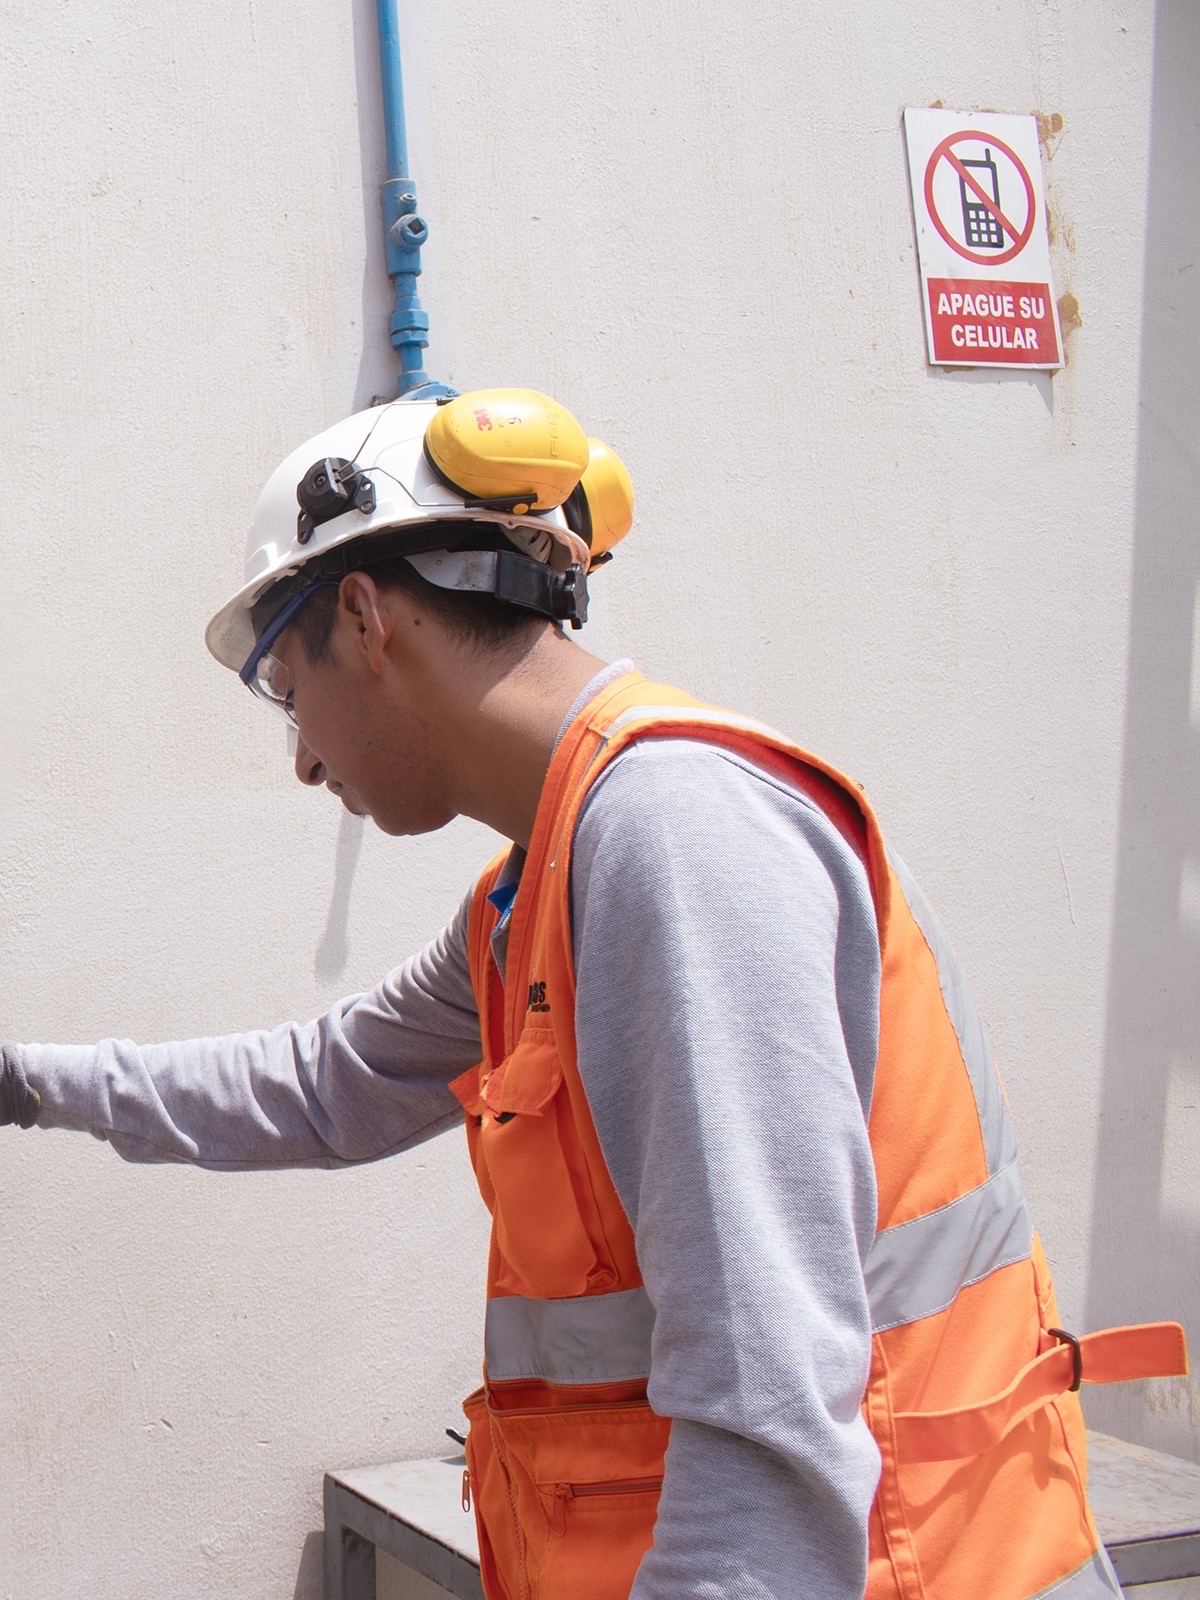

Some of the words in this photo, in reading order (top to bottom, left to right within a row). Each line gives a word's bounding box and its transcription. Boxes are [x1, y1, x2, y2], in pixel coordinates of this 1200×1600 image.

[937, 293, 1015, 318] APAGUE
[1020, 297, 1045, 320] SU
[951, 325, 1039, 350] CELULAR
[473, 409, 493, 431] 3M
